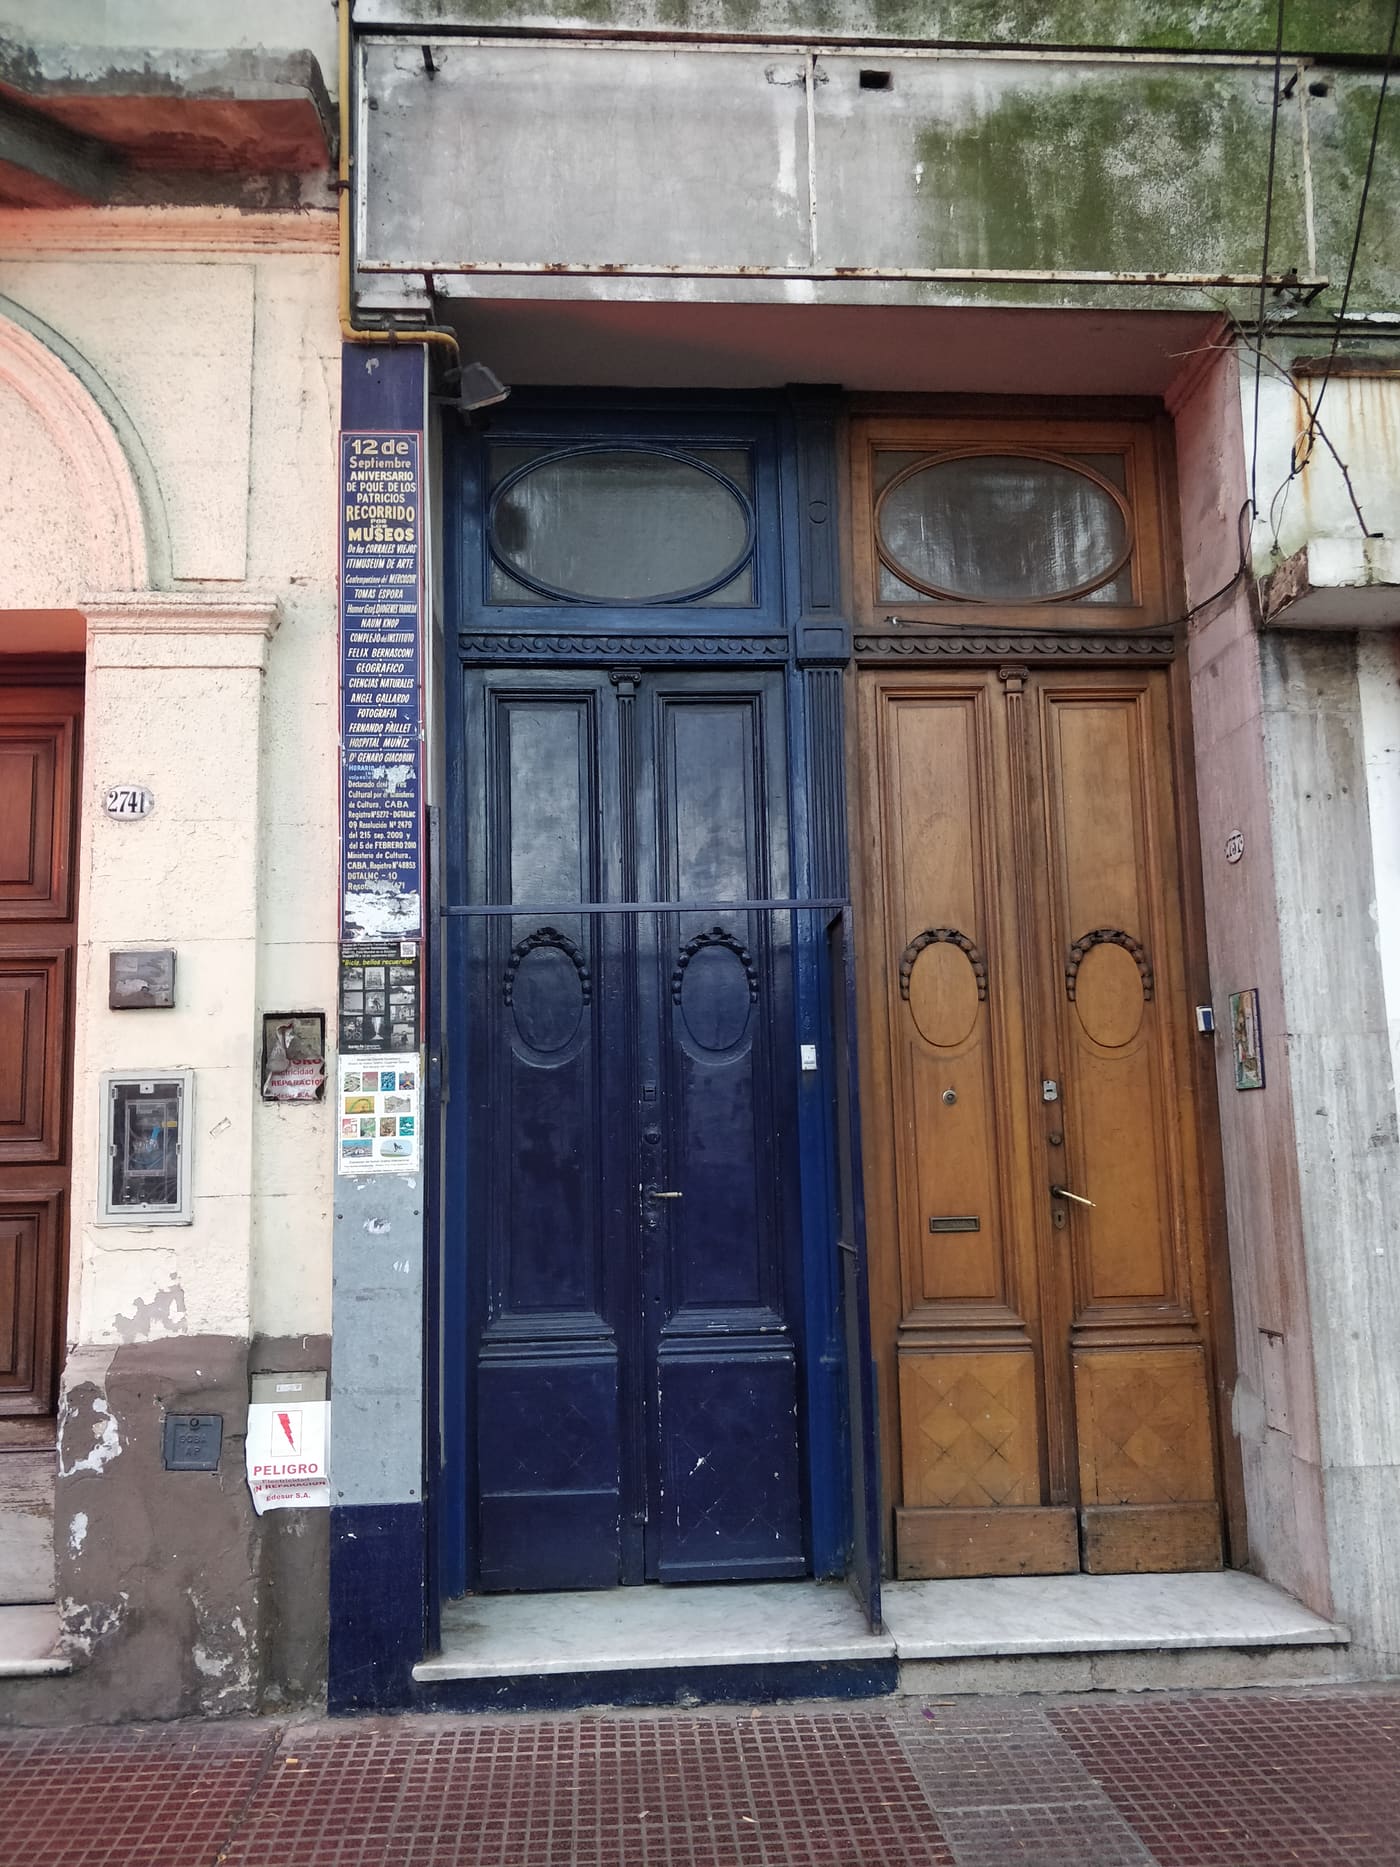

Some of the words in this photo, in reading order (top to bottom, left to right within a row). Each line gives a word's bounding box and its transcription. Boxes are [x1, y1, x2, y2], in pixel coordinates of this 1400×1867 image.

[352, 440, 378, 454] 12
[382, 440, 408, 454] de
[350, 456, 411, 470] Septiembre
[350, 472, 414, 480] ANIVERSARIO
[346, 482, 356, 492] DE
[360, 482, 387, 492] PQUE.
[388, 482, 398, 492] DE
[400, 482, 416, 492] LOS
[356, 494, 405, 503] PATRICIOS
[346, 506, 415, 522] RECORRIDO
[348, 528, 414, 541] MUSEOS
[348, 544, 356, 553] De
[366, 544, 395, 553] CORRALES
[397, 544, 417, 553] VIEJOS
[346, 559, 385, 568] ITIMUSEUM
[386, 559, 396, 568] DE
[396, 559, 414, 568] ARTE
[355, 589, 376, 598] TOMAS
[378, 589, 403, 598] ESPORA
[347, 604, 364, 614] Humor
[361, 619, 381, 628] NAUM
[382, 619, 399, 628] KNOP
[350, 633, 380, 642] COMPLEJO
[386, 633, 414, 642] INSTITUTO
[348, 648, 369, 657] FELIX
[372, 648, 414, 657] BERNASCONI
[356, 663, 404, 673] GEOGRAFICO
[349, 678, 378, 688] CIENCIAS
[380, 678, 414, 688] NATURALES
[351, 694, 372, 703] ANGEL
[376, 694, 410, 703] GALLARDO
[357, 709, 397, 718] FOTOGRAFIA
[349, 723, 383, 732] FERNANDO
[349, 738, 379, 747] HOSPITAL
[383, 736, 409, 747] MUÑIZ
[358, 753, 383, 762] GENARO
[108, 791, 144, 813] 2741
[253, 1464, 318, 1476] PELIGRO
